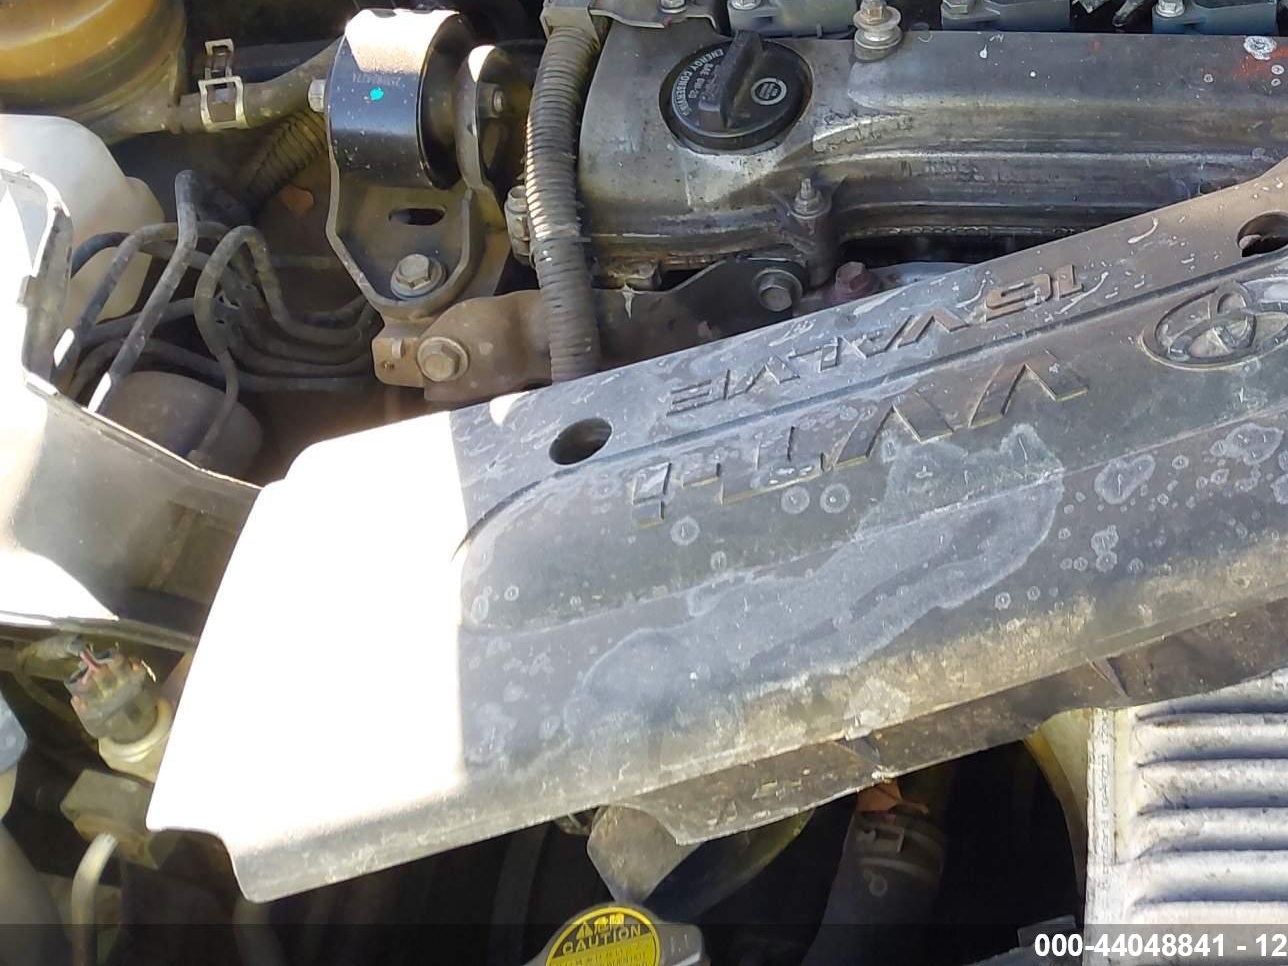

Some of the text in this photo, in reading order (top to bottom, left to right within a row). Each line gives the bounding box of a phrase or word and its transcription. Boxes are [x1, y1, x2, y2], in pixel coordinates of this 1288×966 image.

[692, 48, 724, 71] ENERGY
[703, 62, 714, 77] SAE
[562, 924, 642, 955] CAUTION
